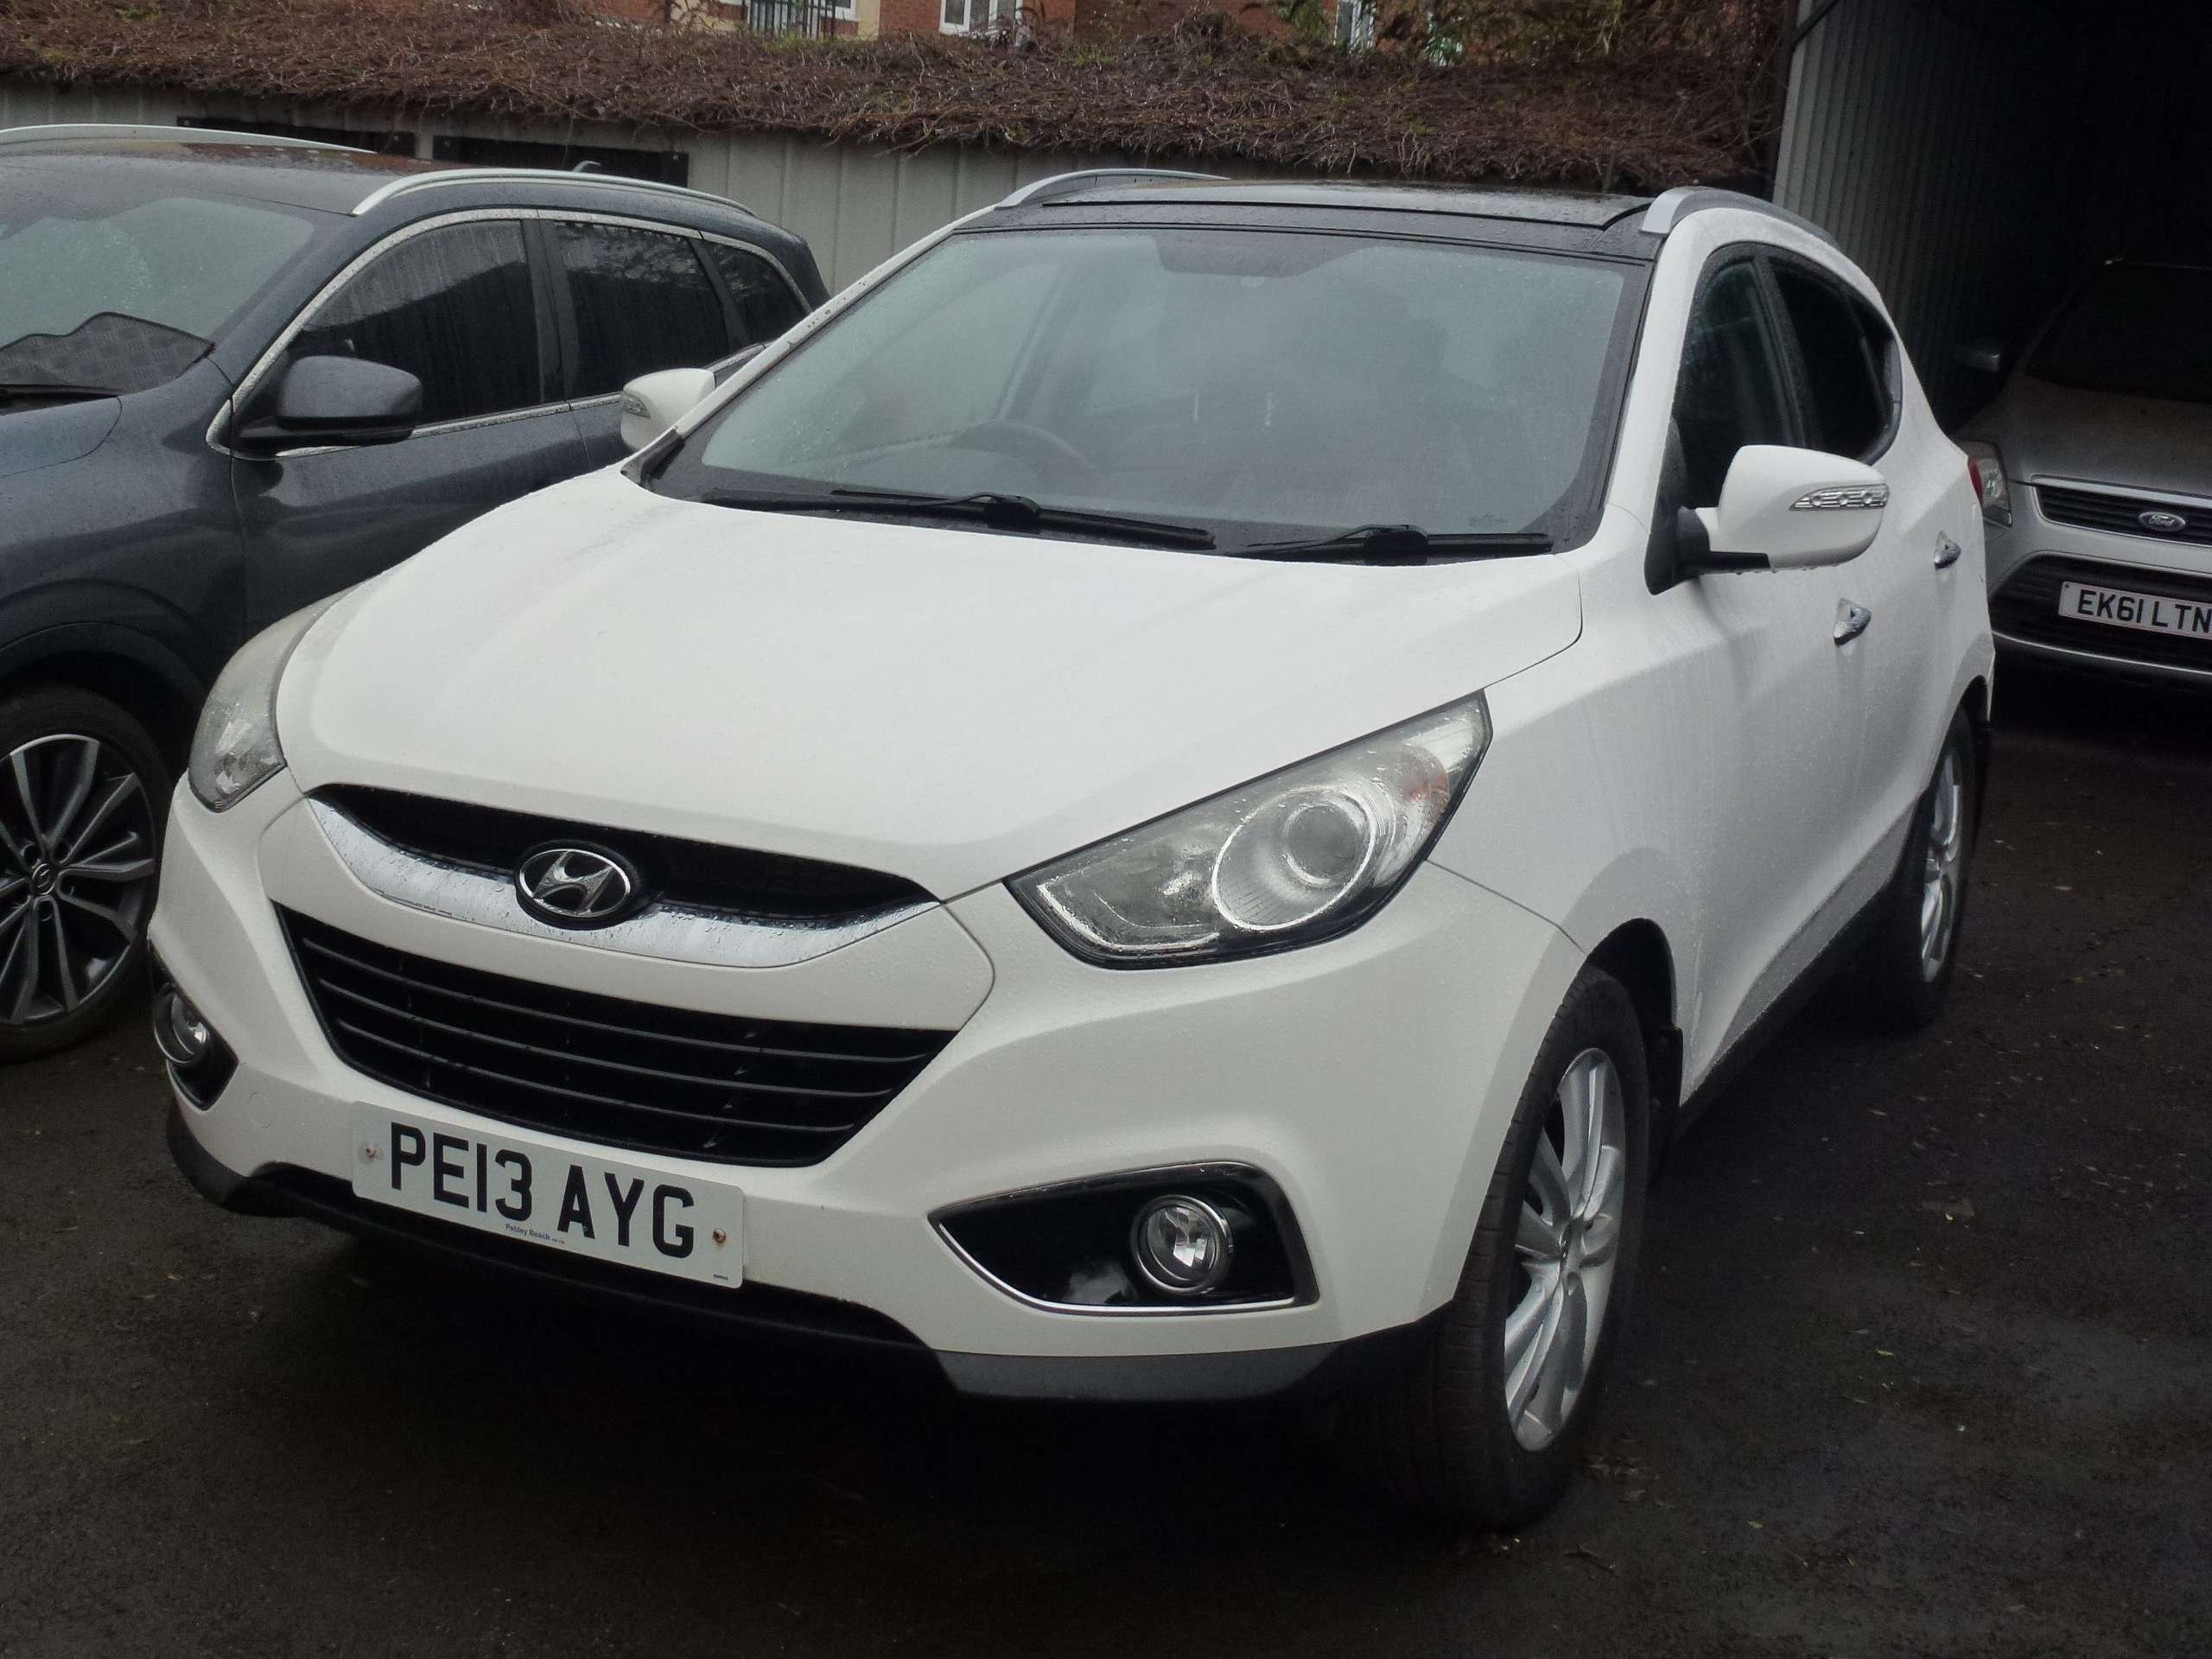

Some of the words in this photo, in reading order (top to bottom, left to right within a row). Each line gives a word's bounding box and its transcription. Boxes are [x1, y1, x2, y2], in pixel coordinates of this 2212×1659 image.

[2077, 589, 2144, 623] EK61
[2152, 601, 2212, 633] LTN
[391, 1122, 532, 1221] PE13
[557, 1165, 695, 1258] AYG
